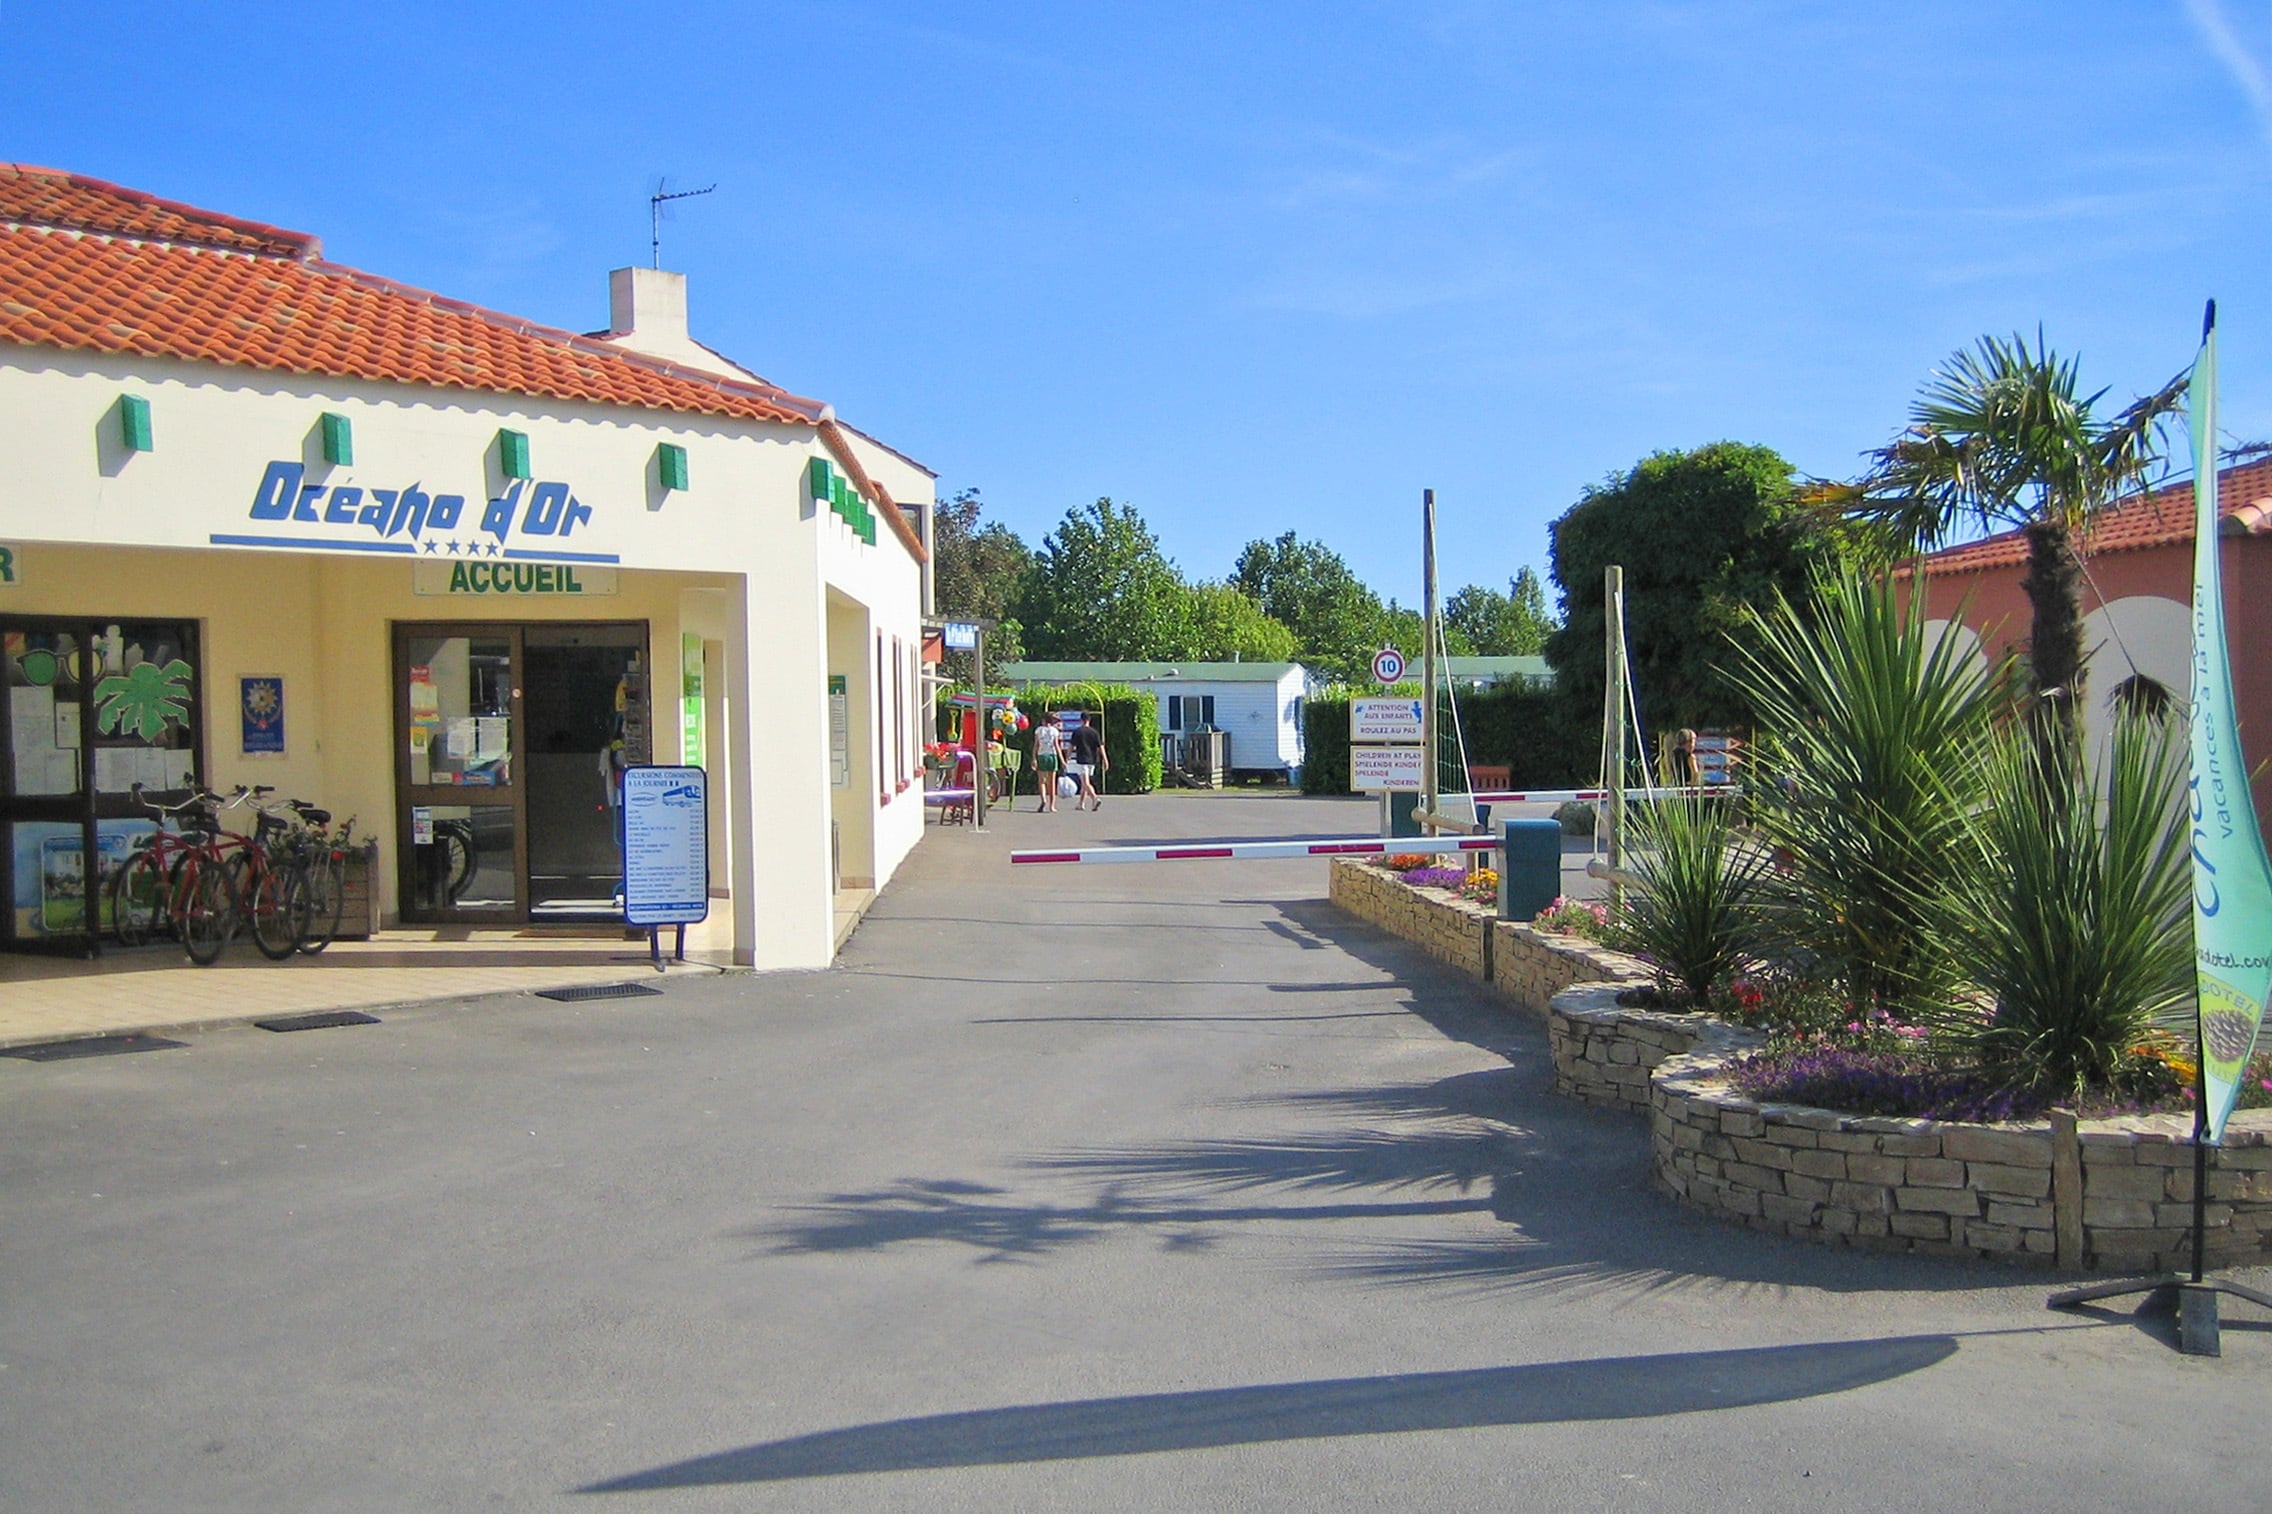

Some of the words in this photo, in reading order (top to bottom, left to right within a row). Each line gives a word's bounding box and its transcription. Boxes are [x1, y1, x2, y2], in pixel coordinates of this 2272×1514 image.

[480, 476, 593, 546] d'Or
[449, 560, 582, 593] ACCUEIL
[1380, 660, 1397, 673] 10
[2200, 712, 2234, 840] vacances
